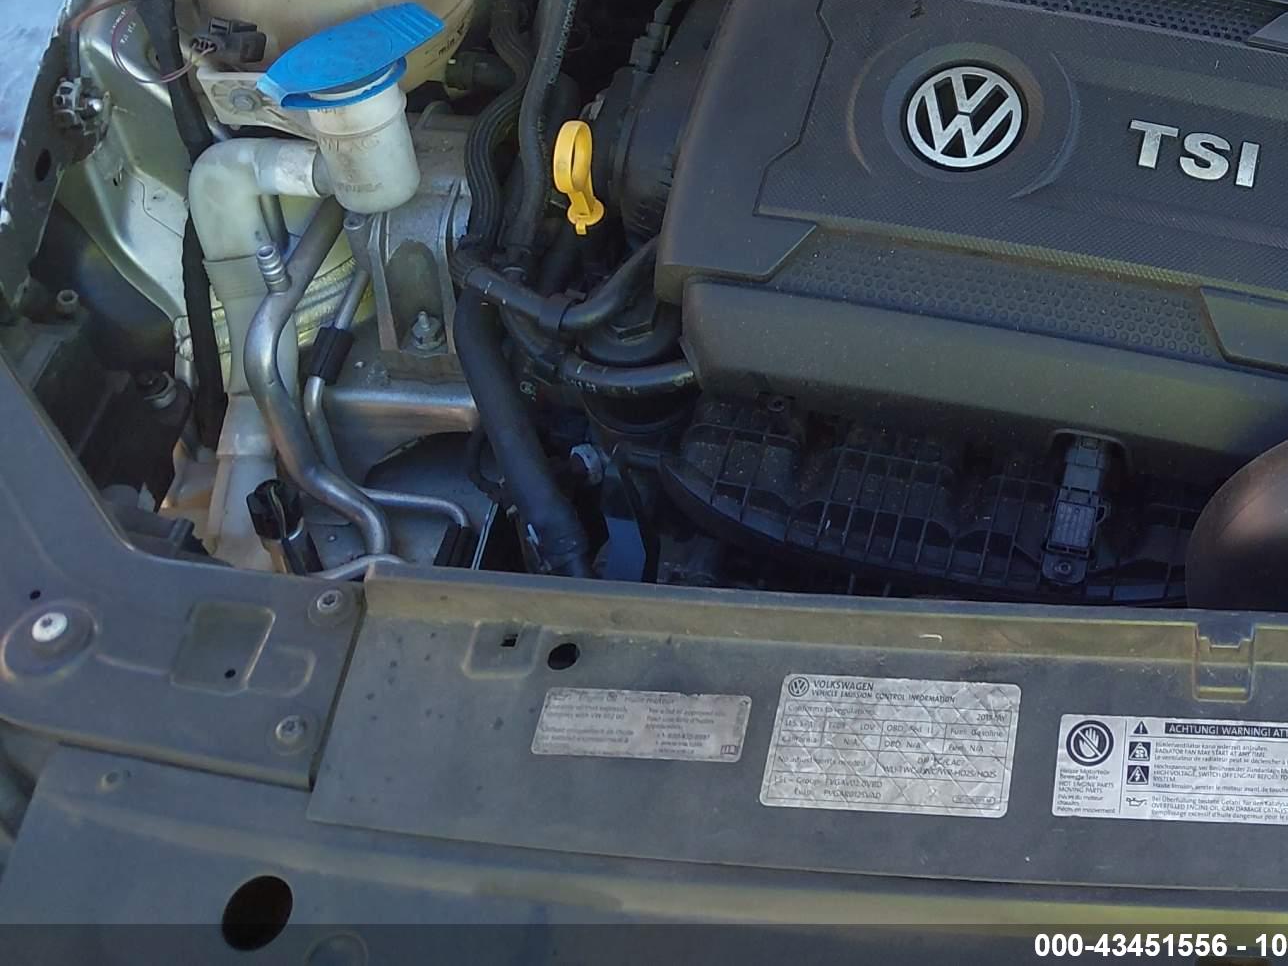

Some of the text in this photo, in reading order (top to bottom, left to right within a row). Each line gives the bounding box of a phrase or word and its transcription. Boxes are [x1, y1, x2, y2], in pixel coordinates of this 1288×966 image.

[1129, 119, 1261, 188] TSI
[813, 680, 874, 691] VOLKSWAGEN
[841, 691, 872, 699] EMISSION
[875, 693, 905, 701] CONTROL
[909, 694, 955, 703] INFORMATION
[1168, 724, 1218, 736] ACHTUNG!
[1221, 726, 1271, 738] WARNING!
